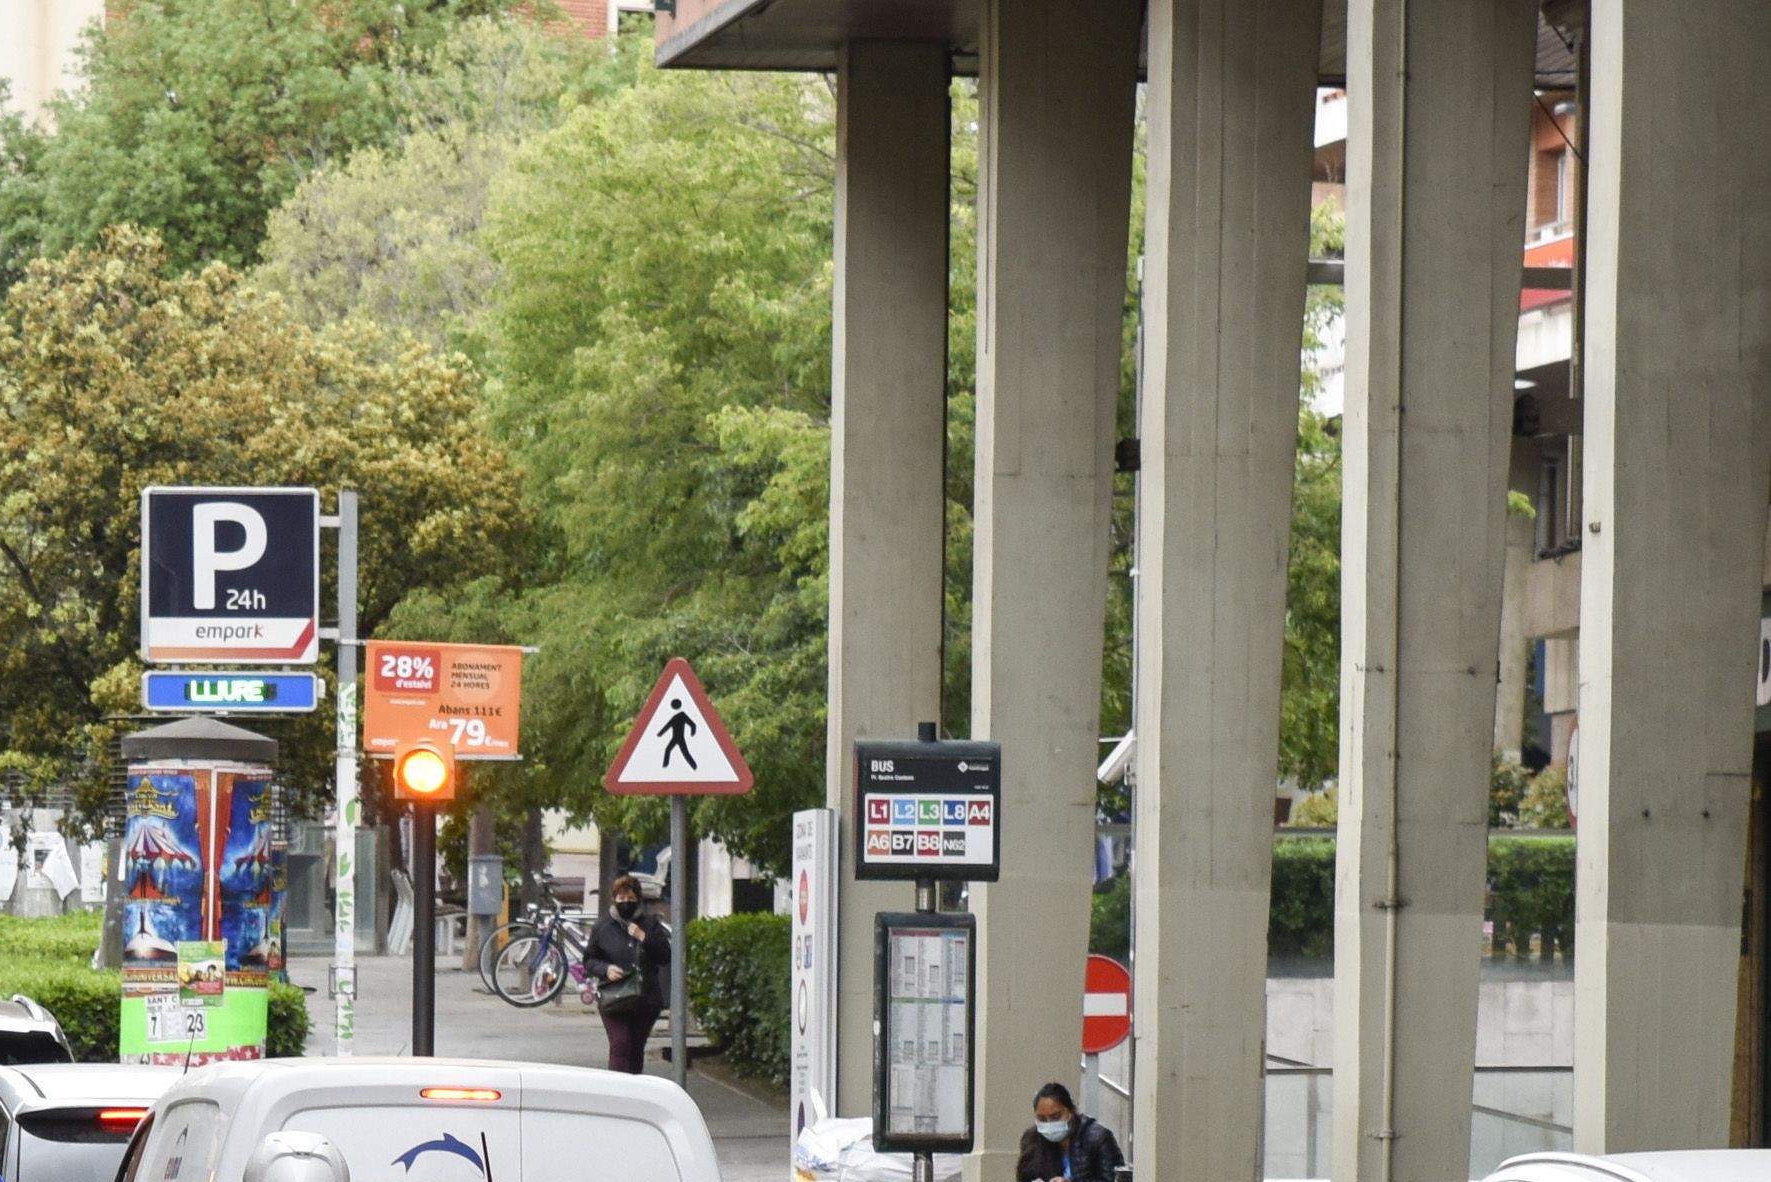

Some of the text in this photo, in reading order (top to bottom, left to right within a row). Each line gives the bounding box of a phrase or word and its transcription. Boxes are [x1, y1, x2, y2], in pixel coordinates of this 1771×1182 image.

[193, 501, 268, 610] P
[226, 589, 266, 610] 24h
[195, 625, 264, 643] empark
[381, 654, 434, 679] 28%
[451, 662, 502, 673] ABONAMENT
[451, 672, 488, 681] MENSUAL
[463, 681, 490, 690] HORES
[438, 704, 471, 716] Abans
[429, 718, 448, 730] Ara
[448, 718, 486, 747] 79
[871, 760, 894, 773] BUS
[871, 803, 990, 820] L1 L2 L3 L8 A4
[868, 834, 965, 851] A6 B7 B8 N62
